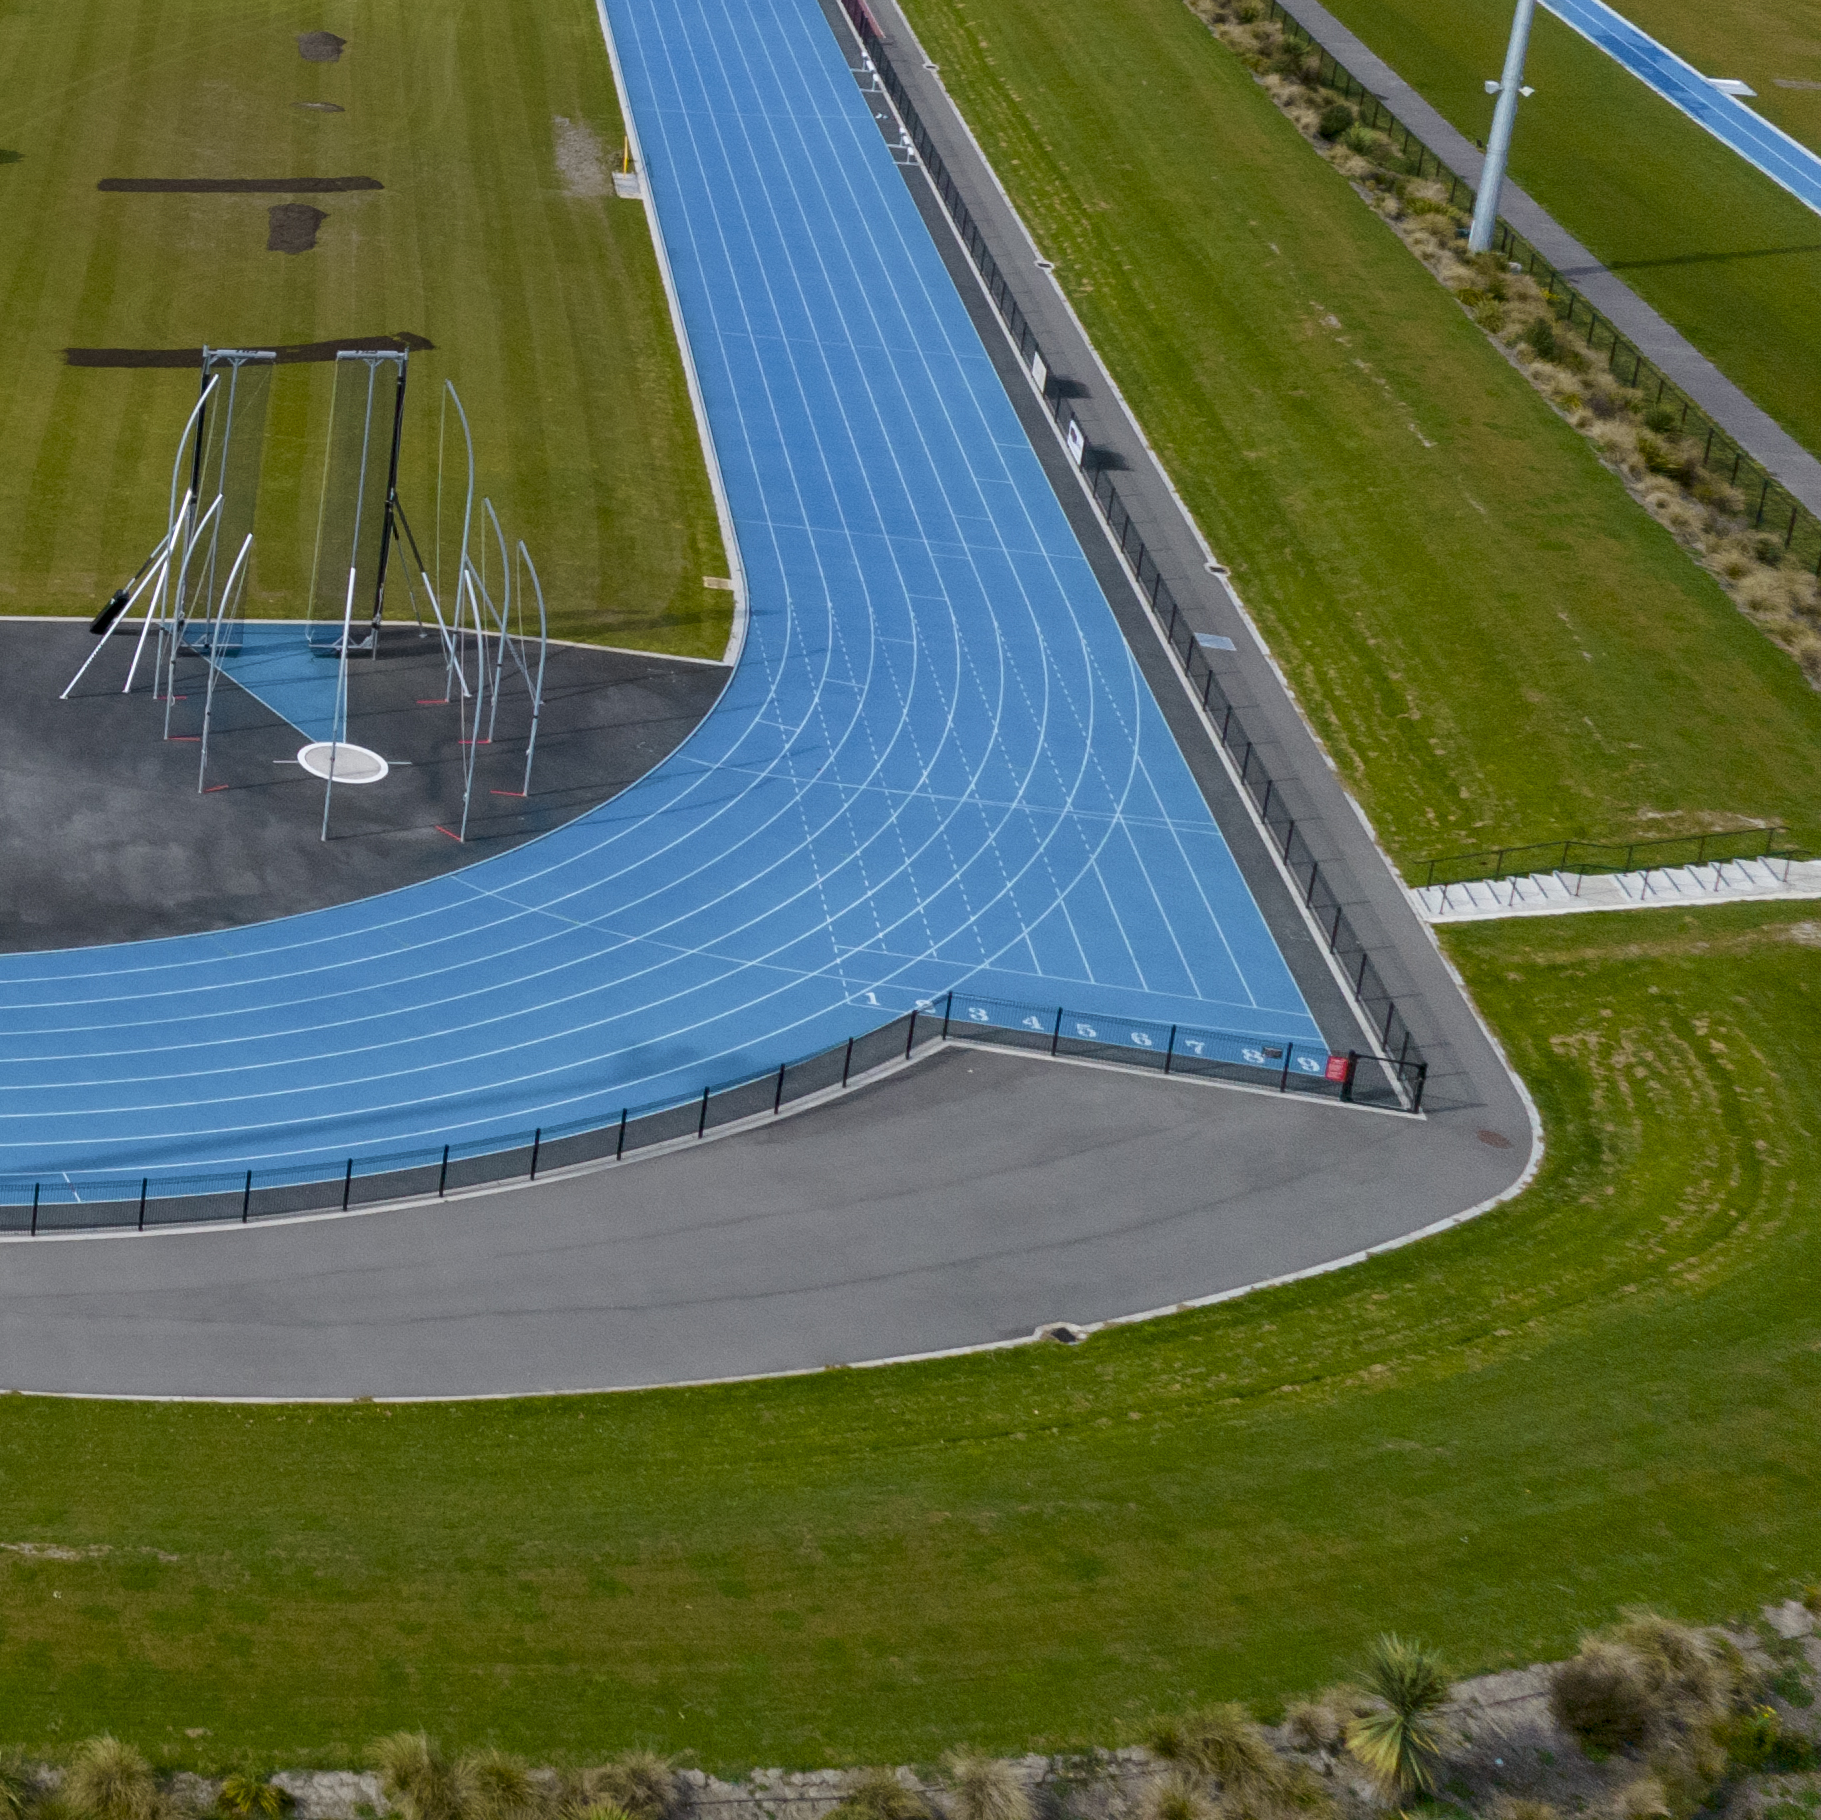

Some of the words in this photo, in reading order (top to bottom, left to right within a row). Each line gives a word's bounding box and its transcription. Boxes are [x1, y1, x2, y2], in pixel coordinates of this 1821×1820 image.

[865, 992, 881, 1006] 1
[915, 999, 937, 1014] 2
[968, 1007, 989, 1021] 3
[1022, 1016, 1044, 1030] 4
[1076, 1023, 1097, 1038] 5
[1130, 1033, 1153, 1047] 6
[1184, 1040, 1206, 1055] 7
[1241, 1048, 1265, 1064] 8
[1297, 1057, 1320, 1072] 9
